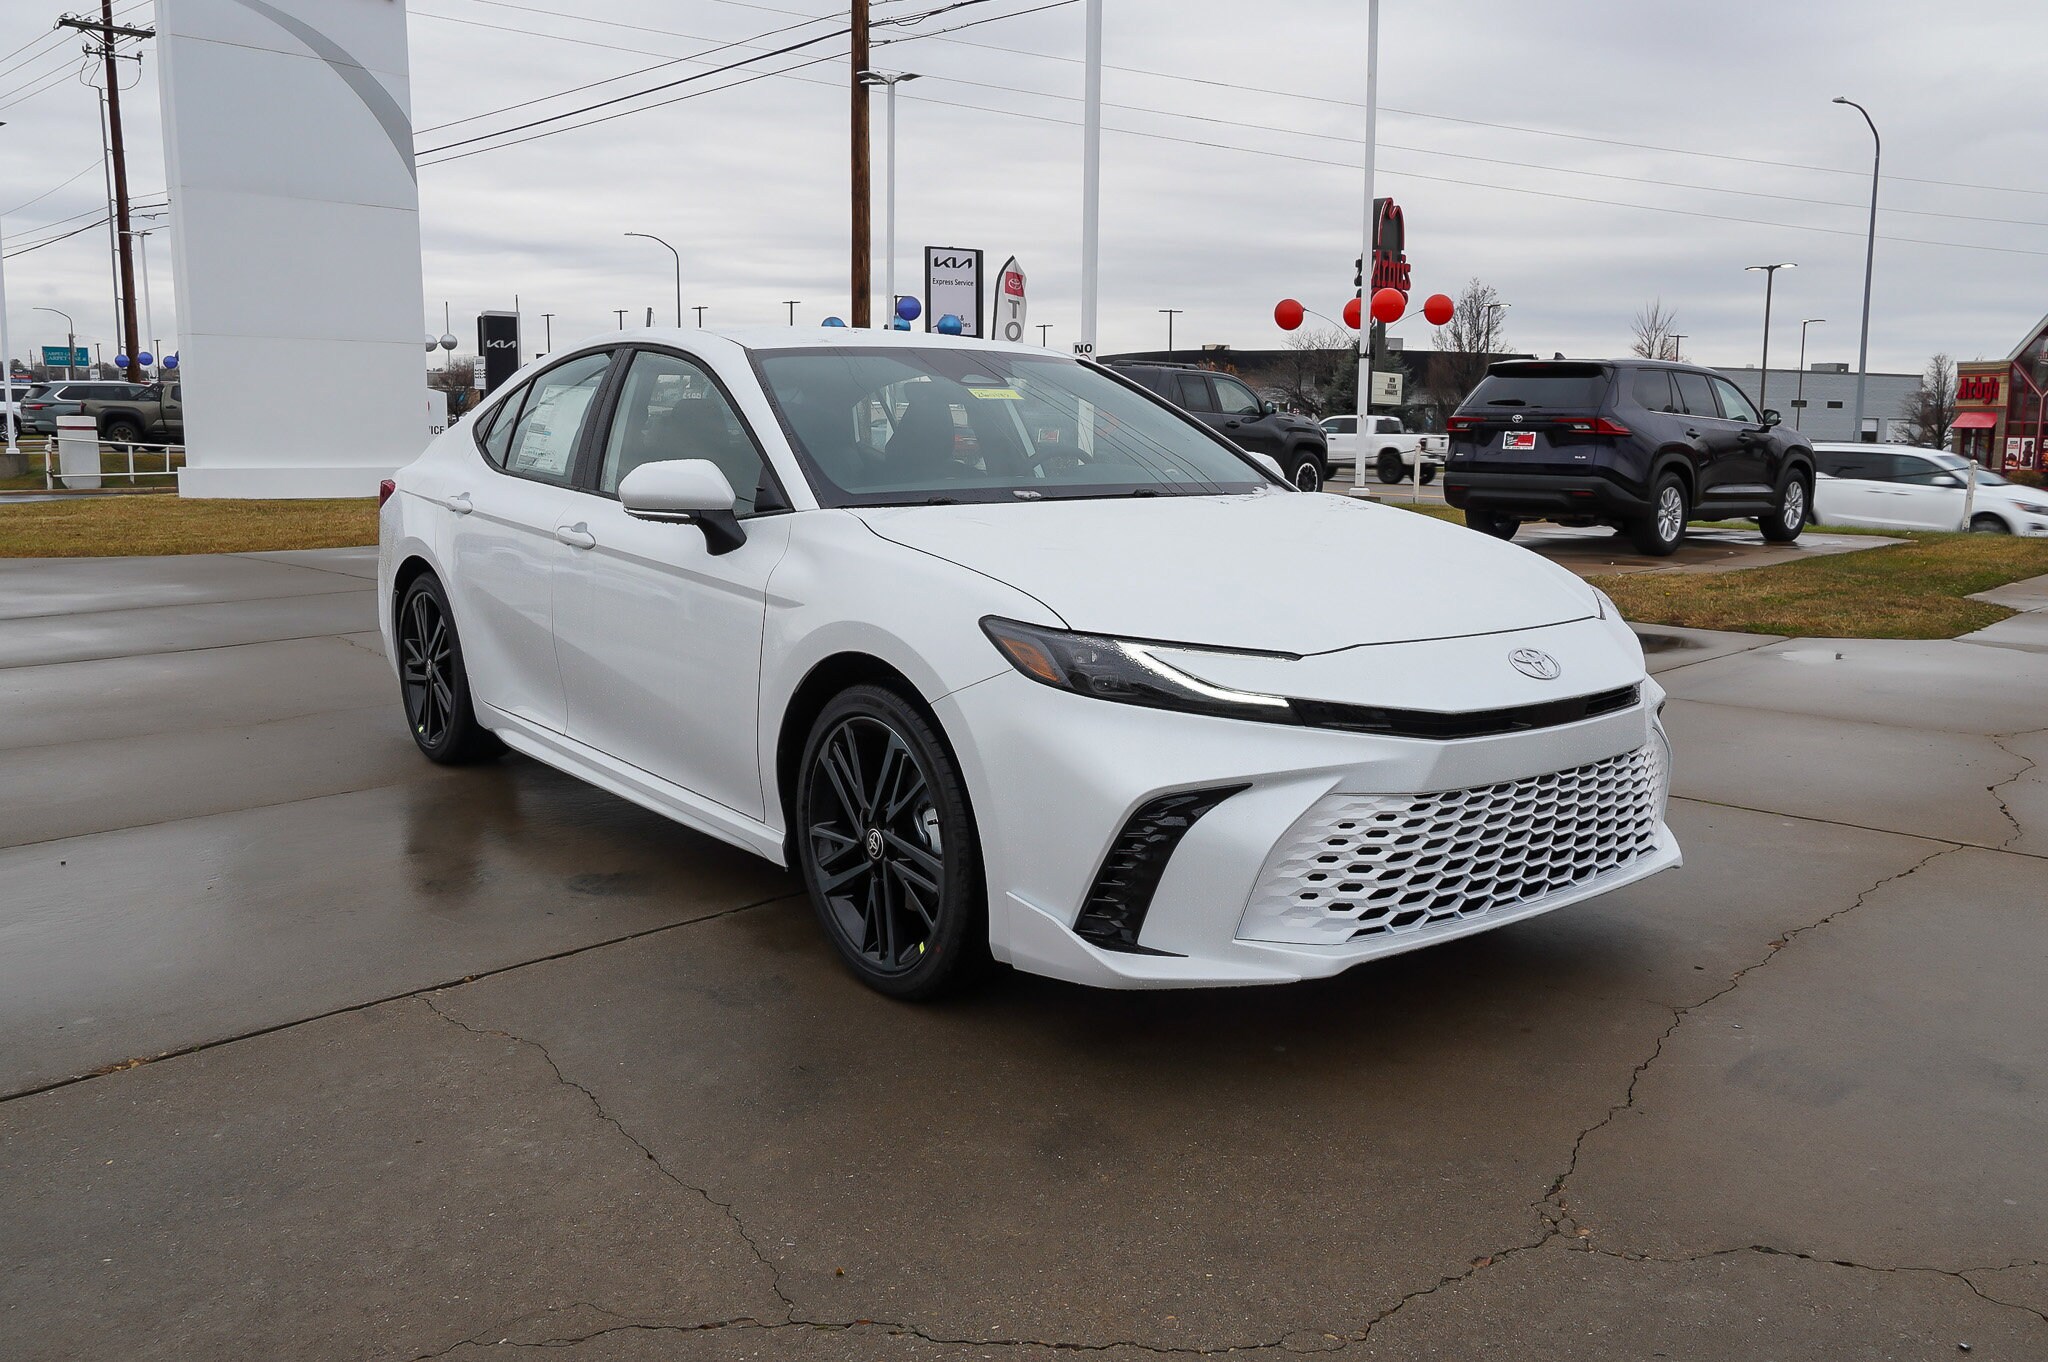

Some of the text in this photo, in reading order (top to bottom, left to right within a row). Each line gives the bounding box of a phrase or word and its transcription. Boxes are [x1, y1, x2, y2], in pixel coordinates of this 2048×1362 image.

[933, 256, 973, 269] KIA
[932, 277, 974, 287] Express Service
[486, 339, 516, 349] KIA
[1074, 343, 1093, 354] NO
[1956, 376, 2000, 404] Arby's
